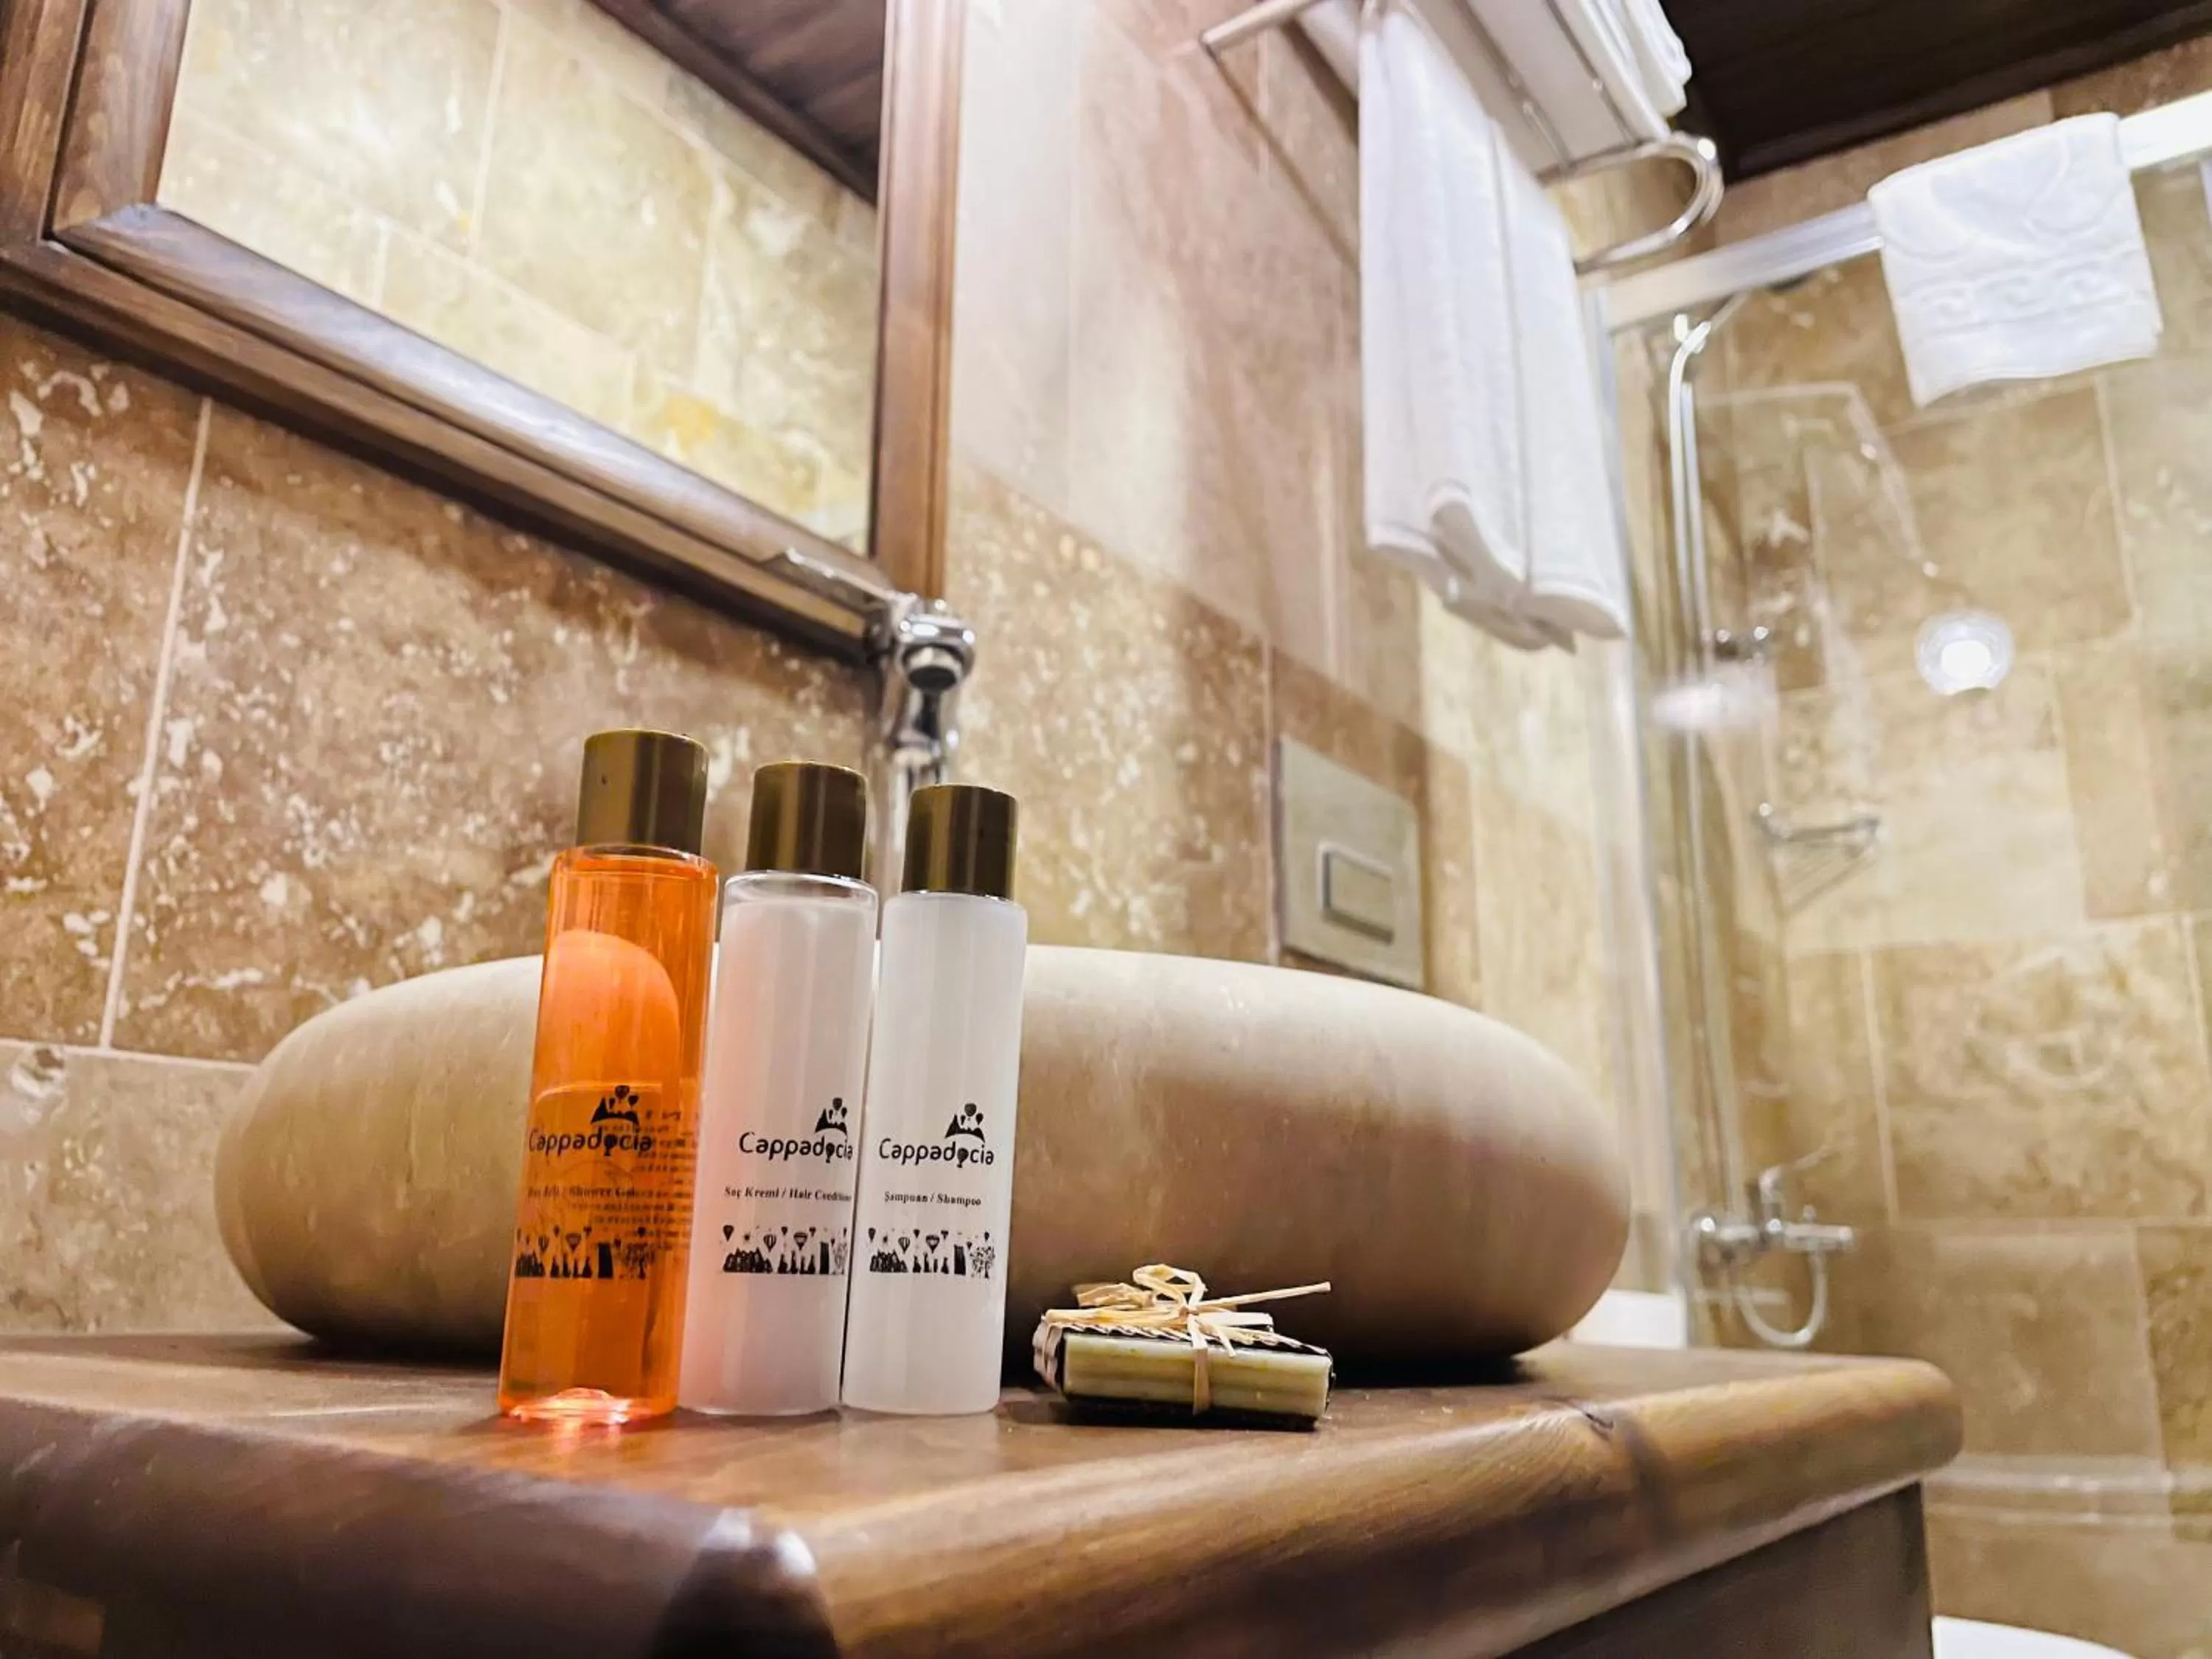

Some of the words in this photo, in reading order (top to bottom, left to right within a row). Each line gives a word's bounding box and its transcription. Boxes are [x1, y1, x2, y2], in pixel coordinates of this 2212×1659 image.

[528, 1127, 653, 1156] Cappadocia
[739, 1132, 853, 1164] Cappadocia
[879, 1138, 995, 1169] Cappadocia
[782, 1186, 787, 1198] /
[790, 1189, 812, 1199] Hair
[884, 1192, 928, 1203] Şampuan
[930, 1192, 935, 1203] /
[936, 1193, 981, 1207] Shampoo
